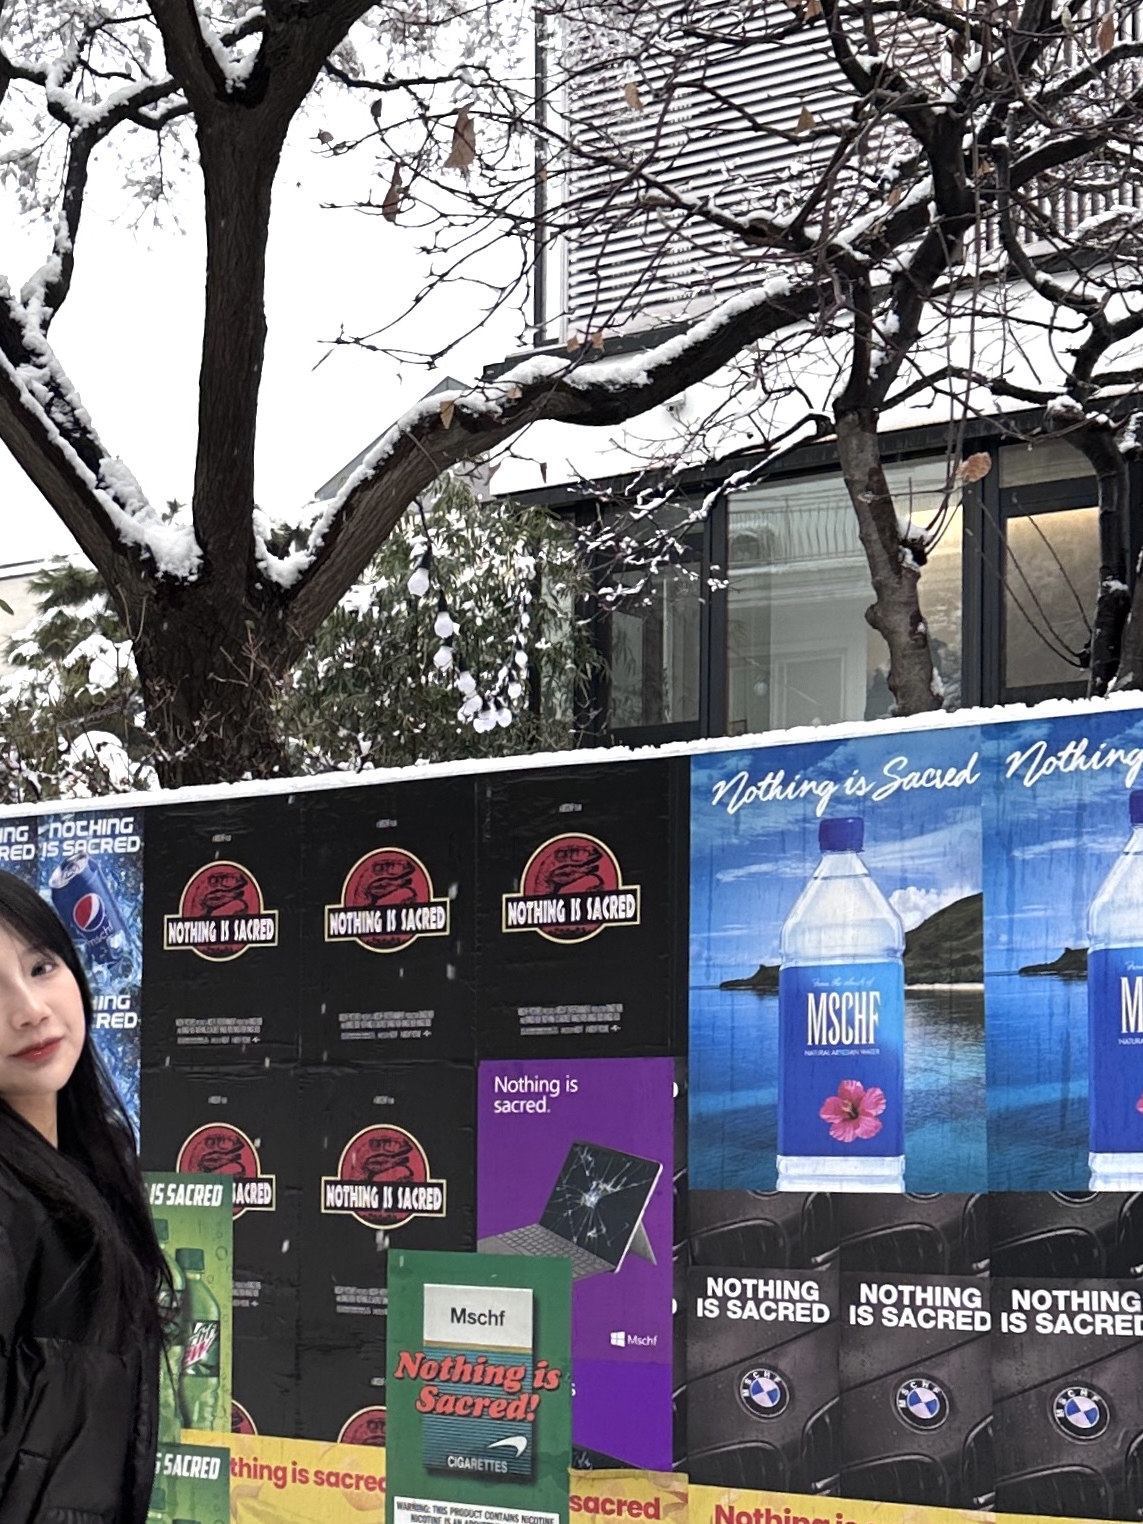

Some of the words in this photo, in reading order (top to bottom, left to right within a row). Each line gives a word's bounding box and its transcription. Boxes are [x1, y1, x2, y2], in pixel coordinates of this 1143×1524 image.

[1006, 737, 1143, 789] Nothing
[711, 769, 839, 817] Nothing
[844, 769, 875, 797] is
[871, 751, 981, 802] Sacred
[48, 816, 134, 839] NOTHING
[42, 841, 59, 858] IS
[61, 835, 141, 856] SACRED
[329, 911, 383, 935] NOTHING
[386, 908, 397, 932] IS
[401, 905, 446, 931] SACRED
[508, 899, 566, 926] NOTHING
[570, 898, 582, 921] IS
[586, 894, 636, 921] SACRED
[168, 919, 217, 944] NOTHING
[220, 919, 231, 942] IS
[234, 917, 275, 941] SACRED
[92, 1012, 139, 1029] RED
[807, 990, 881, 1046] MSCHF
[494, 1075, 561, 1098] Nothing
[565, 1075, 579, 1093] is
[494, 1095, 551, 1114] sacred.
[149, 1183, 165, 1206] IS
[166, 1183, 223, 1207] SACRED
[326, 1184, 379, 1209] NOTHING
[383, 1185, 393, 1209] IS
[397, 1186, 443, 1211] SACRED
[706, 1276, 820, 1302] NOTHING
[860, 1283, 983, 1310] NOTHING
[1011, 1289, 1142, 1313] NOTHING
[450, 1307, 506, 1327] Mschf
[696, 1298, 720, 1319] IS
[726, 1299, 831, 1325] SACRED
[849, 1305, 875, 1327] IS
[881, 1306, 992, 1333] SACRED
[1001, 1311, 1028, 1334] IS
[627, 1334, 658, 1347] Mschf
[394, 1351, 526, 1394] Nothing
[533, 1360, 562, 1390] is
[742, 1370, 781, 1398] MSCHF
[415, 1385, 541, 1422] Sacred!
[898, 1380, 941, 1409] MSCHF
[1055, 1389, 1101, 1418] MSCHF
[162, 1453, 222, 1481] SACRED
[230, 1457, 287, 1490] thing
[291, 1460, 310, 1485] is
[447, 1455, 508, 1474] CIGARETTES
[396, 1501, 431, 1514] WARNING:
[432, 1505, 448, 1515] THIS
[450, 1507, 483, 1519] PRODUCT
[484, 1510, 520, 1523] CONTAINS
[569, 1493, 661, 1521] sacred
